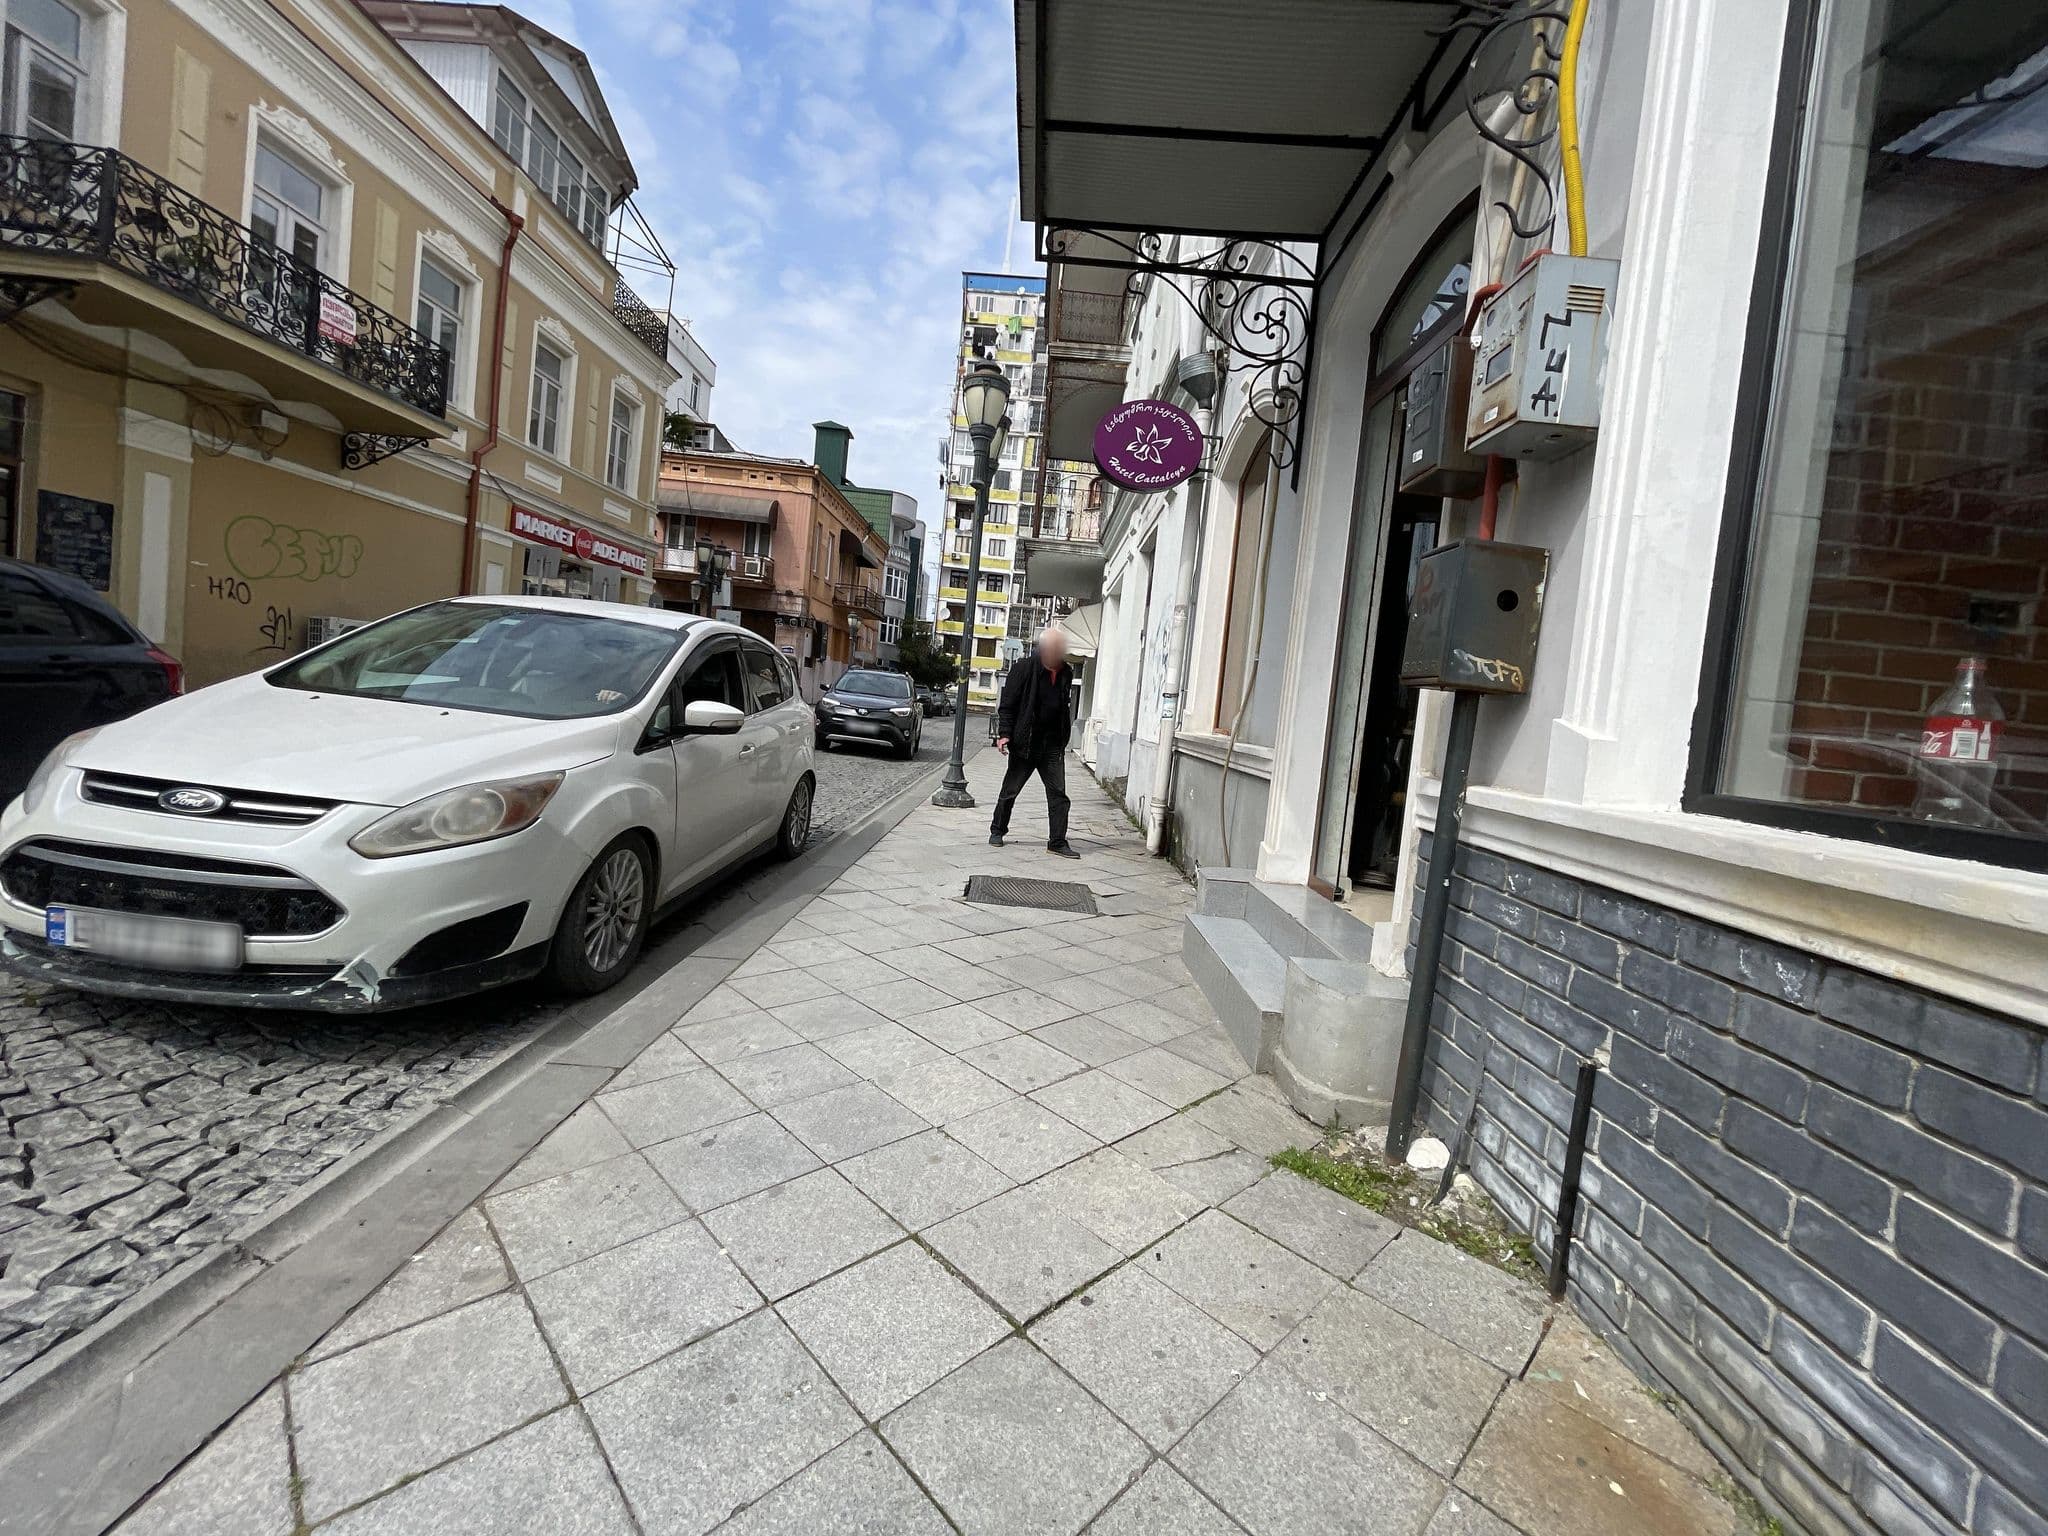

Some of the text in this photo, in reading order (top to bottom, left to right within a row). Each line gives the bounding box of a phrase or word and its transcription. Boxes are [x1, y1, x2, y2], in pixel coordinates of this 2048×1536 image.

[1108, 456, 1135, 479] Hotel
[515, 512, 647, 571] MARKET ADELANTE
[170, 792, 206, 806] Ford
[49, 928, 65, 941] GE
